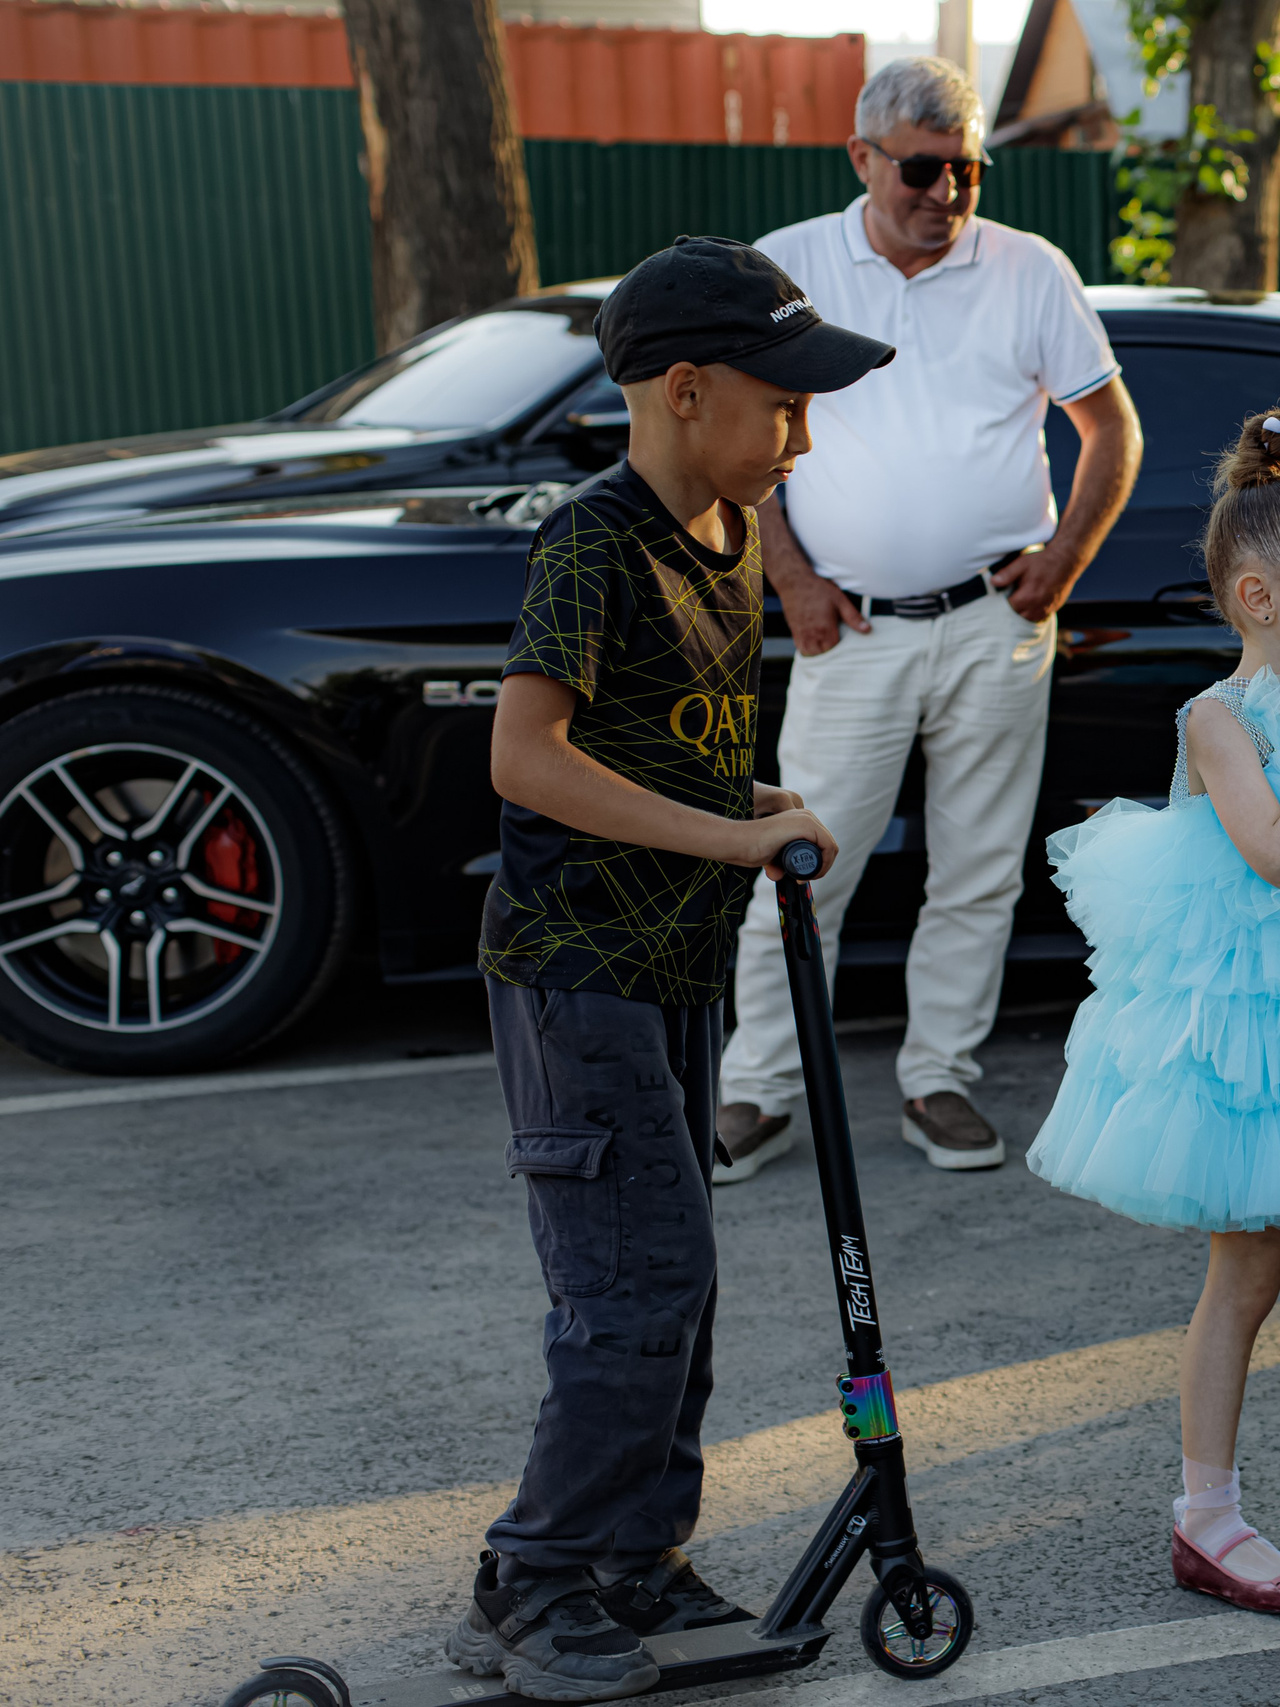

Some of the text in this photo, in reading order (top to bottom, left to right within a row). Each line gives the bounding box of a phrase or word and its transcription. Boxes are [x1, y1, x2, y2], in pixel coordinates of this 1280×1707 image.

[669, 693, 757, 757] QAT
[839, 1234, 877, 1331] TECH TEAM
